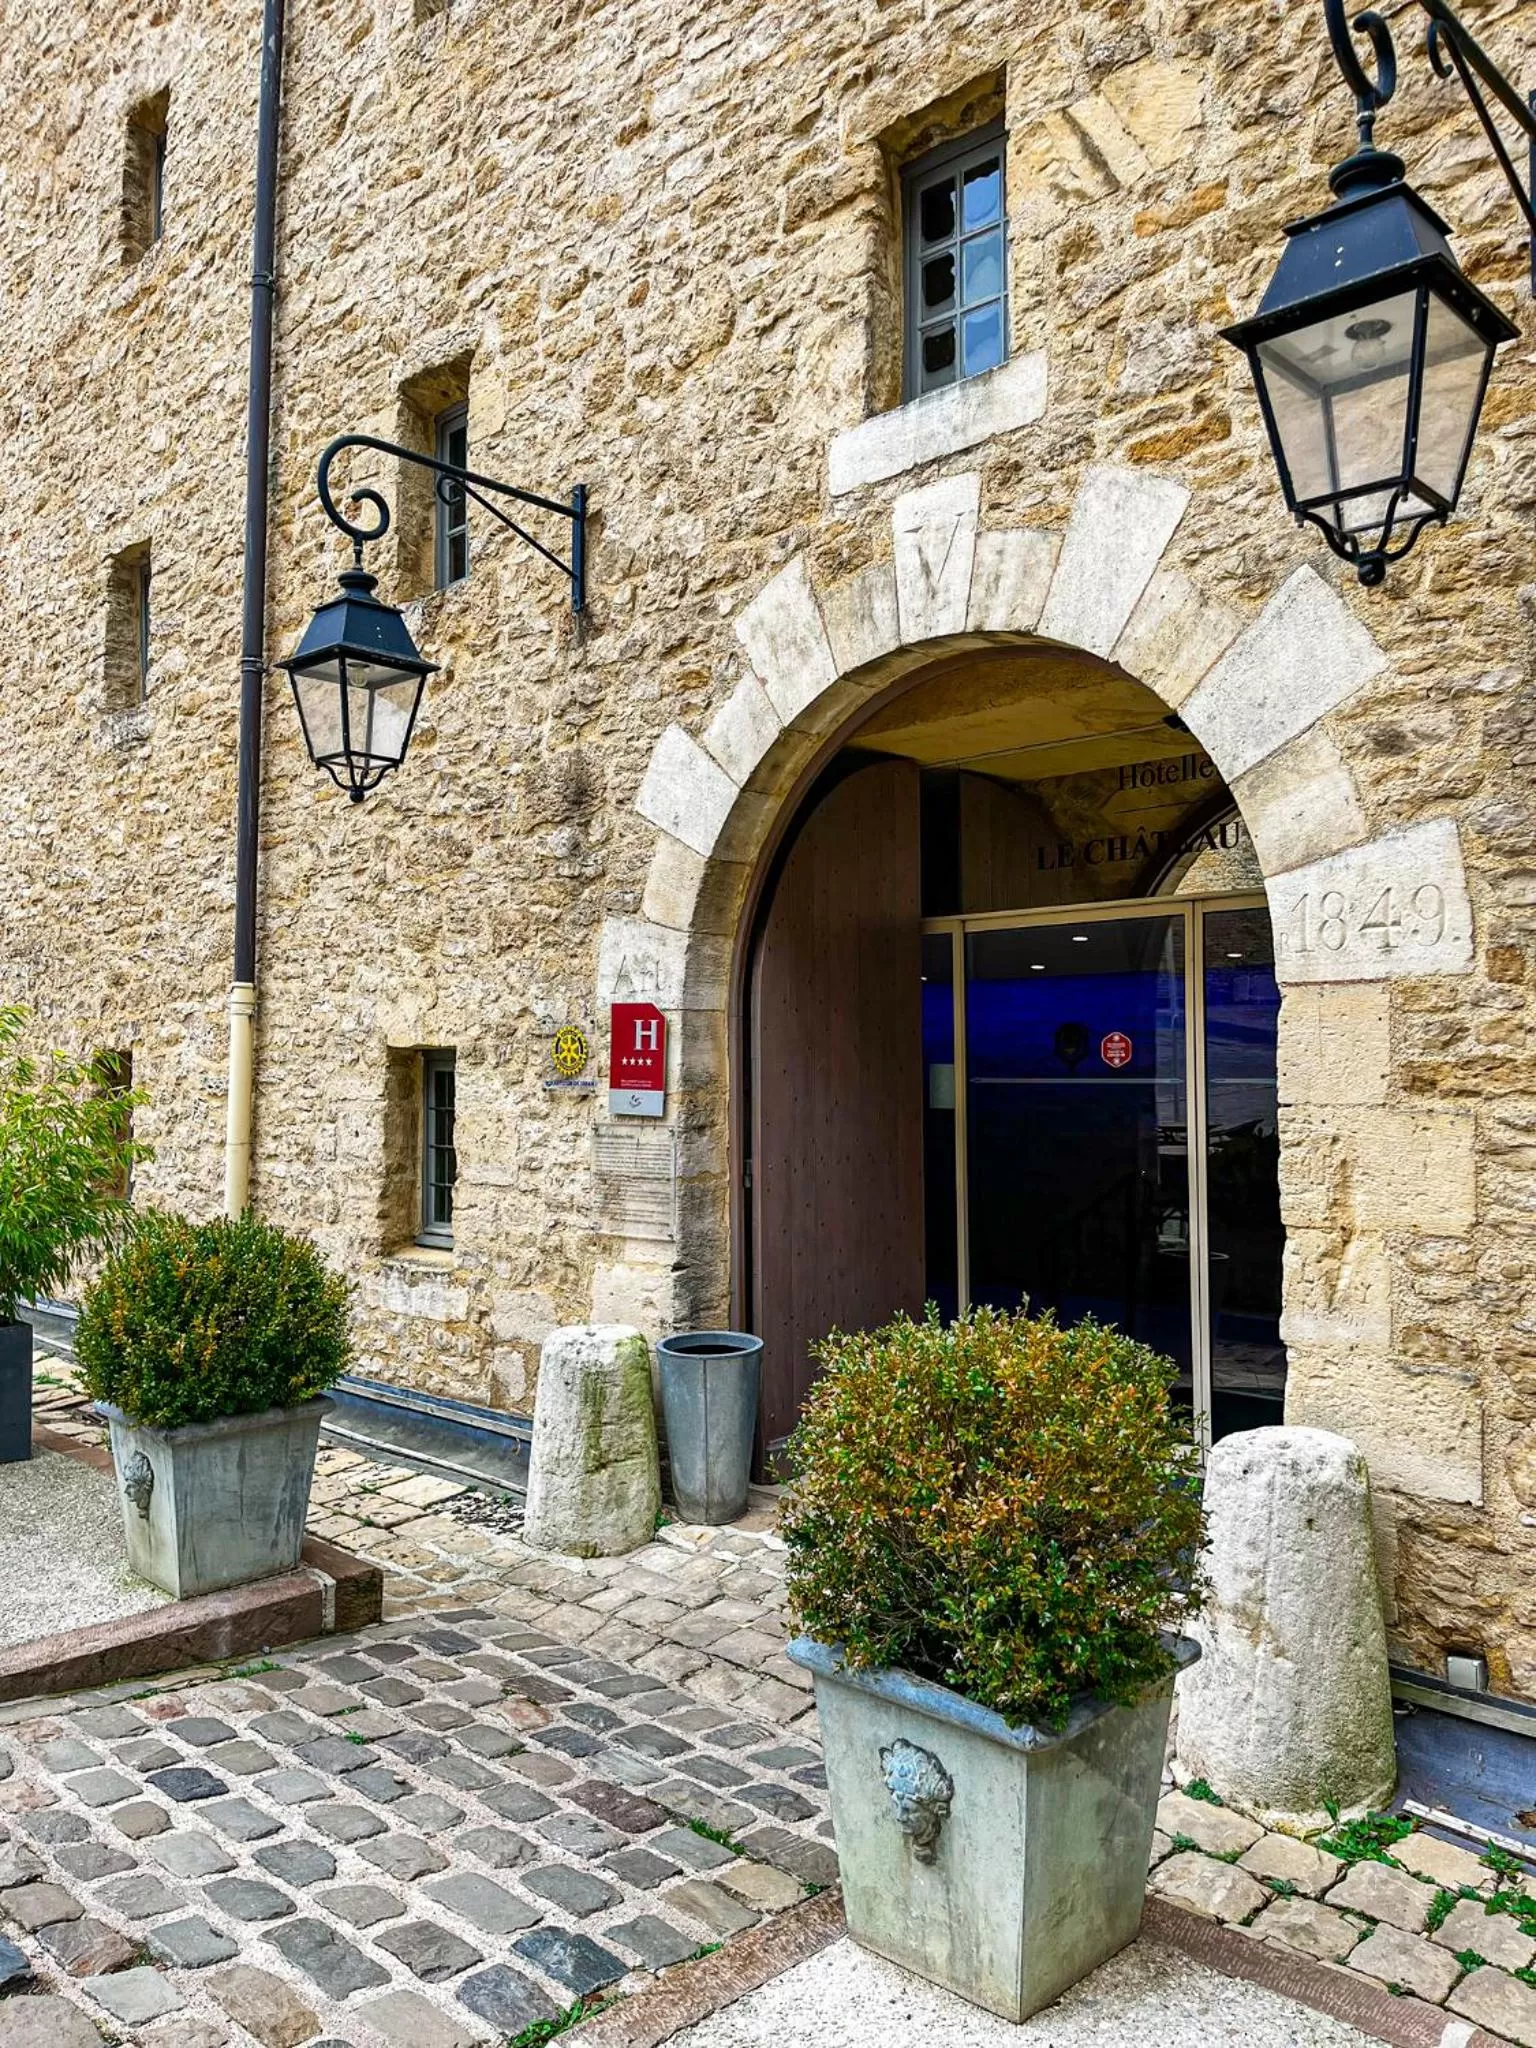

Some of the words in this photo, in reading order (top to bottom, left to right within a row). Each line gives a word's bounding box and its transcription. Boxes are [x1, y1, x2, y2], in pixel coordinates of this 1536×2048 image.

[1036, 843, 1075, 871] LE
[1083, 820, 1240, 866] CHÂTAU
[633, 1019, 660, 1051] H
